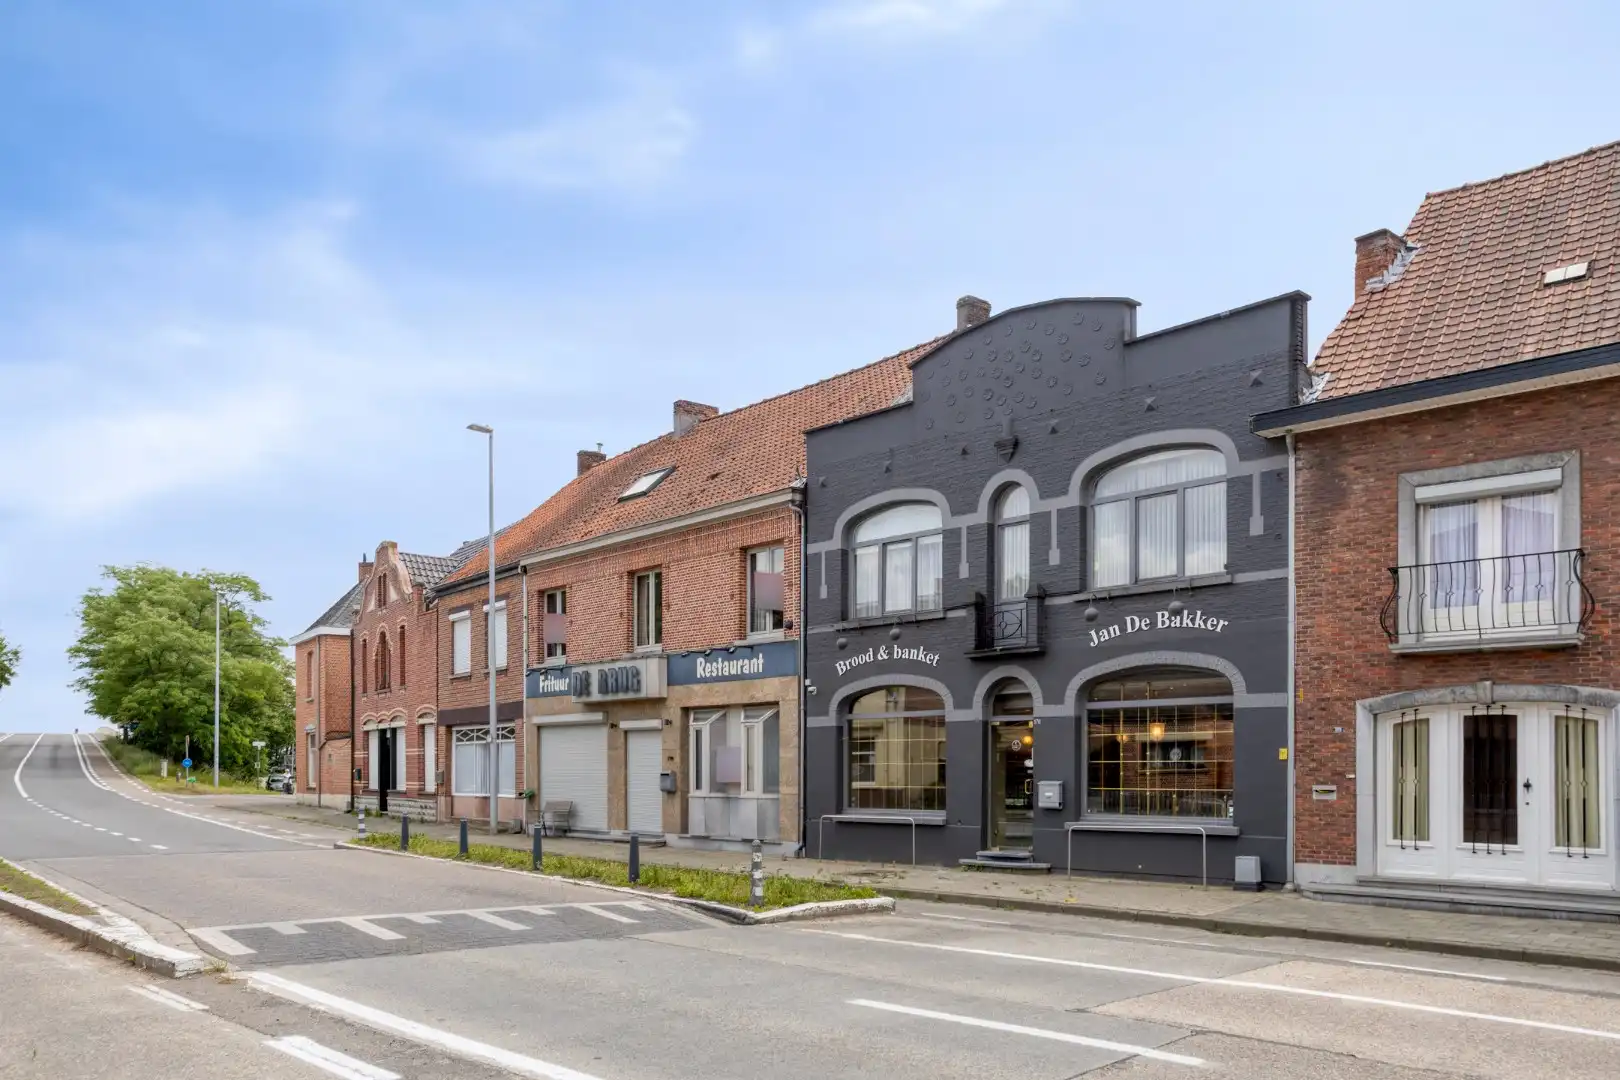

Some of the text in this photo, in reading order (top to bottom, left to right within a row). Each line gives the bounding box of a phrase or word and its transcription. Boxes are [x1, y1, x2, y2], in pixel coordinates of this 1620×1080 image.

[1089, 609, 1229, 647] Jan De Bakker
[696, 653, 764, 678] Restaurant
[835, 645, 940, 676] Brood & banket
[540, 674, 569, 693] Frituur
[572, 665, 642, 697] DE BRUG
